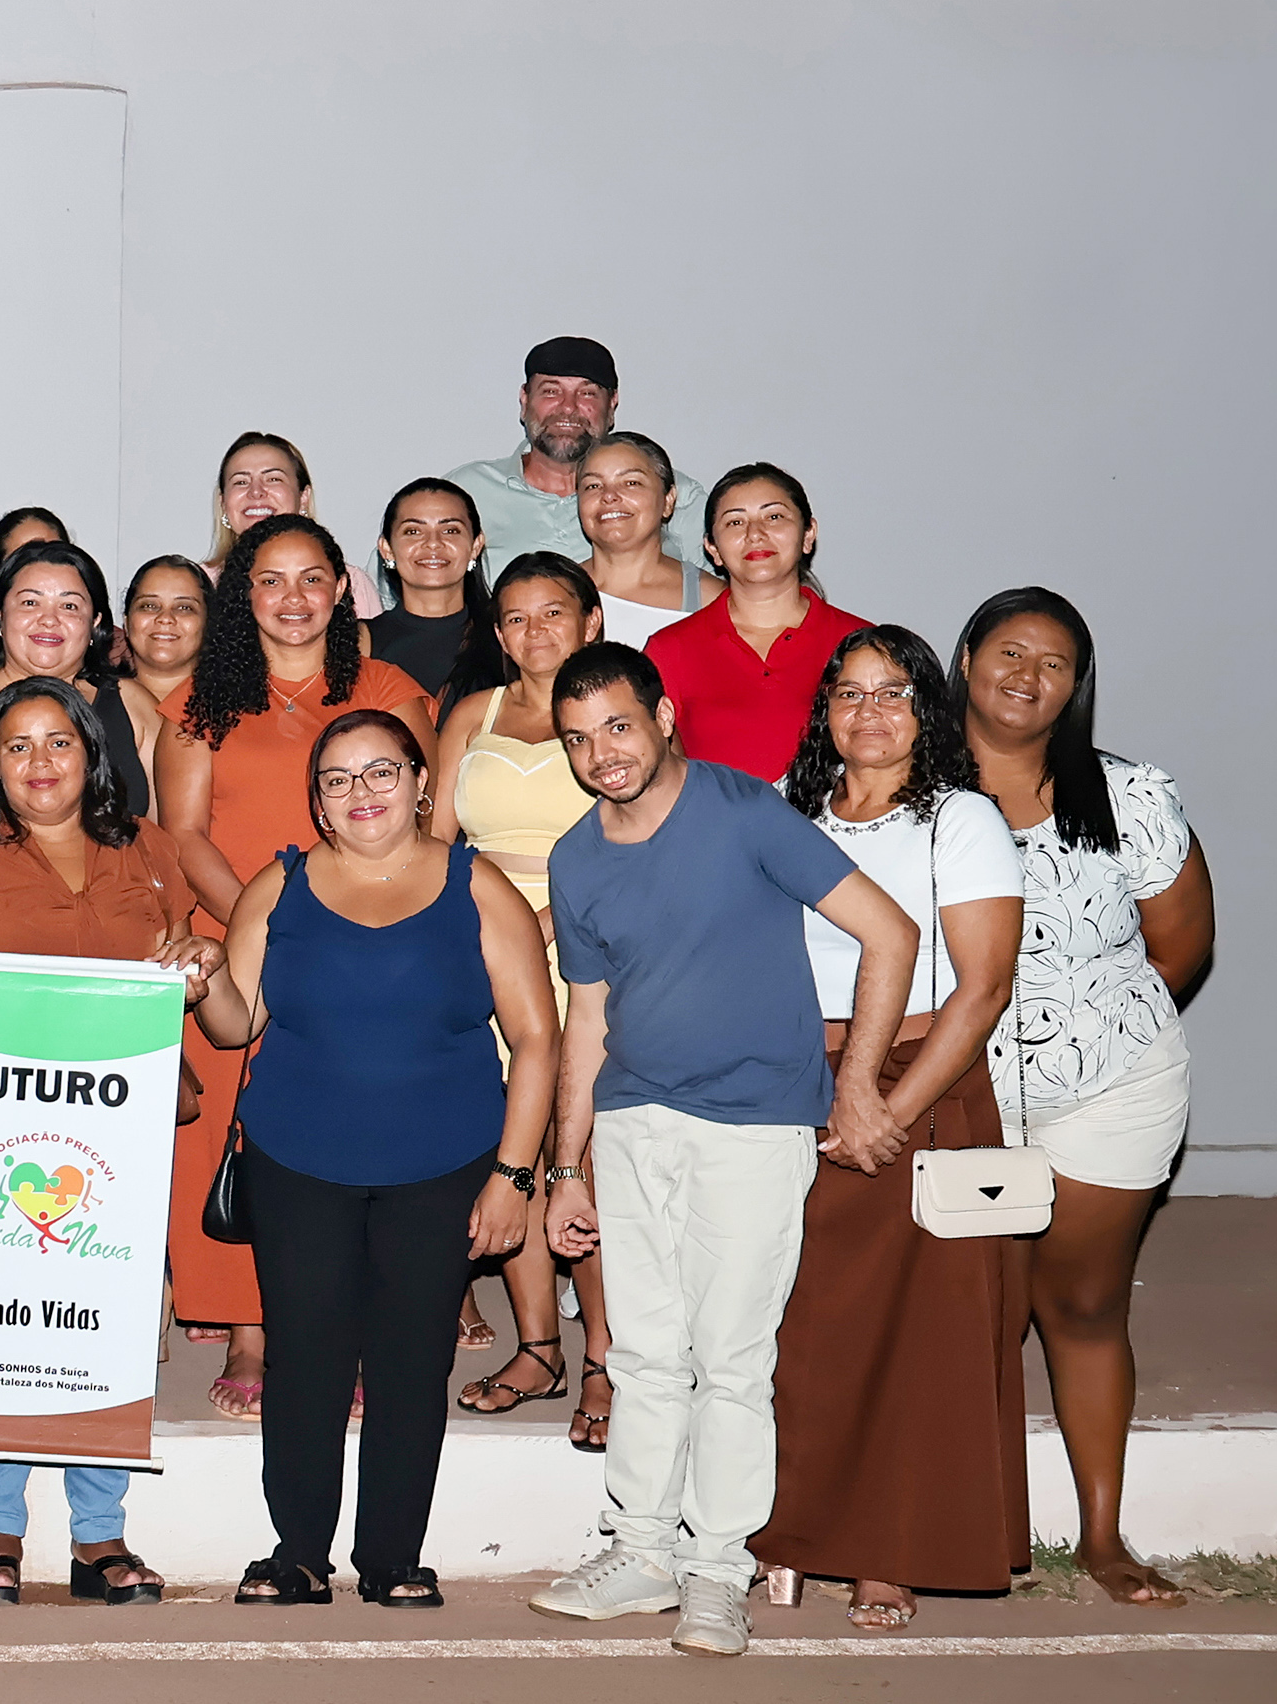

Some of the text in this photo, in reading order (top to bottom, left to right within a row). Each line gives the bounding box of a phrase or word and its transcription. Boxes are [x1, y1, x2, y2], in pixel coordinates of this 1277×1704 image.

[64, 1137, 116, 1182] PRECAVI
[61, 1221, 134, 1261] Nova
[41, 1300, 101, 1331] Vidas
[34, 1378, 54, 1389] dos
[56, 1380, 110, 1393] Nogueiras
[44, 1366, 58, 1375] da
